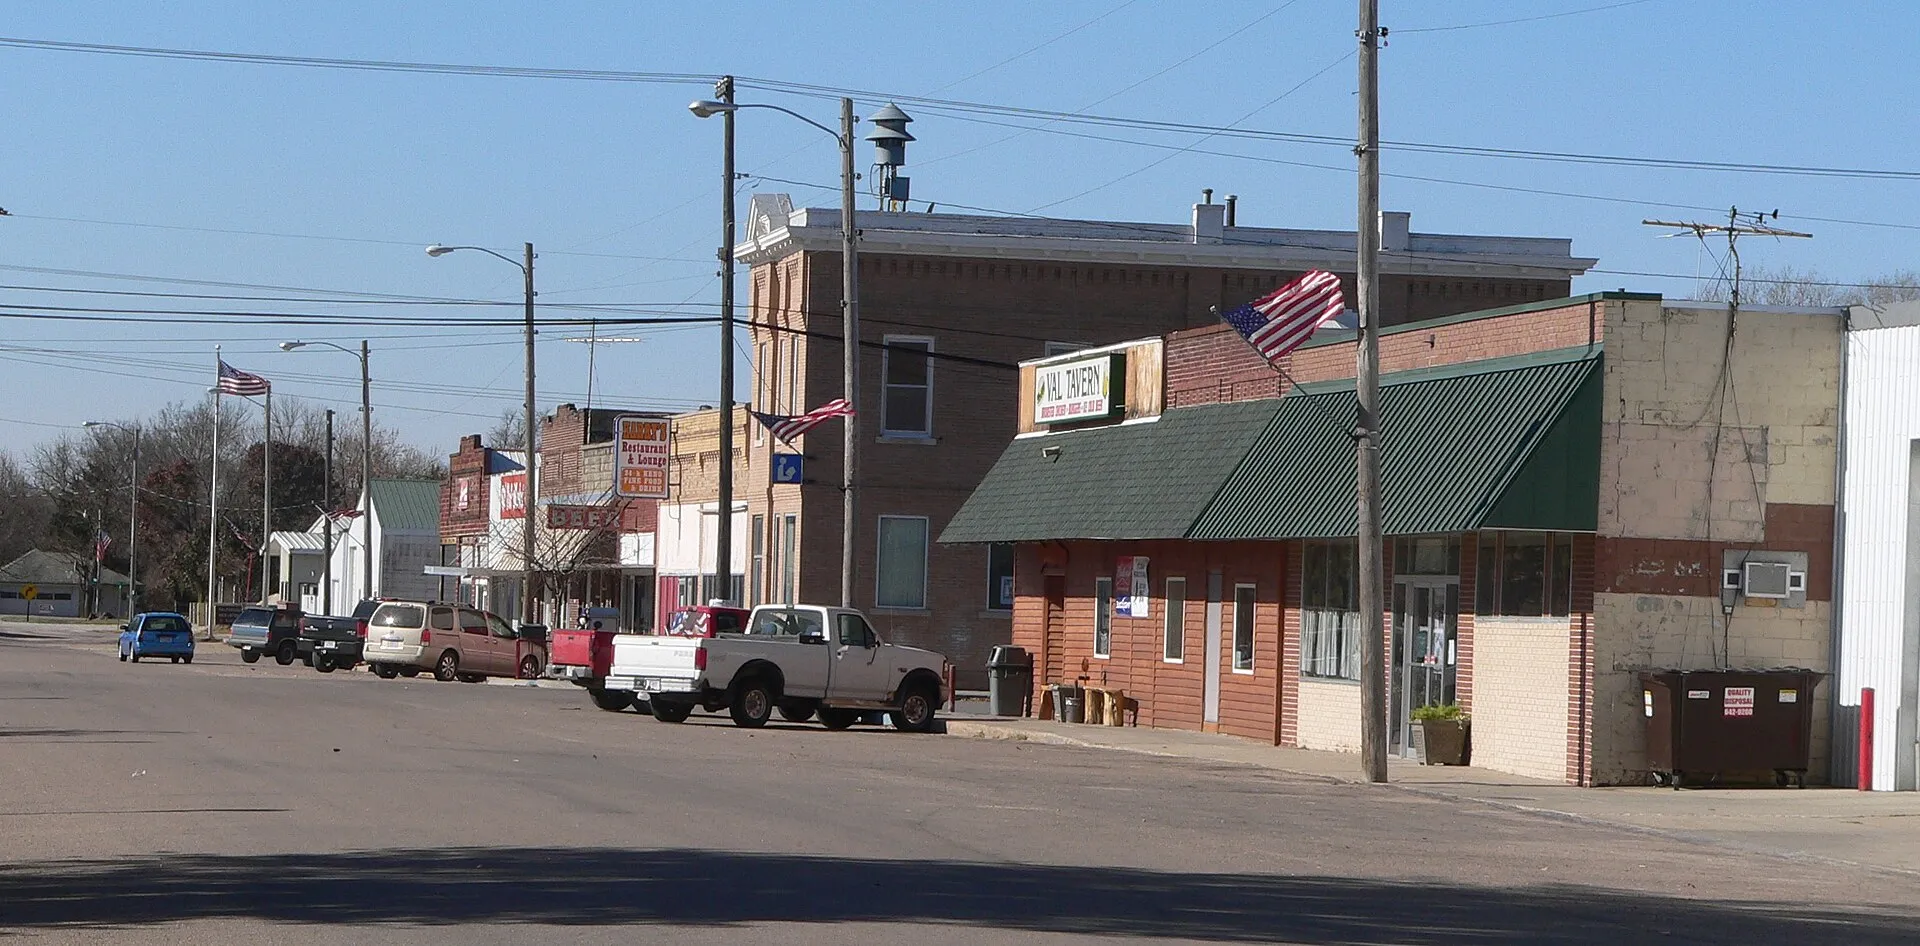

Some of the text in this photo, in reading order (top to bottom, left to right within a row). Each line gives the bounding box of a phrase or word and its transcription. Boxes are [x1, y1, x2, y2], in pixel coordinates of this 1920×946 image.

[1047, 365, 1100, 402] VAL TAVERN
[622, 441, 667, 454] Restaurant
[628, 454, 666, 467] & Lounge
[554, 507, 620, 528] BEER
